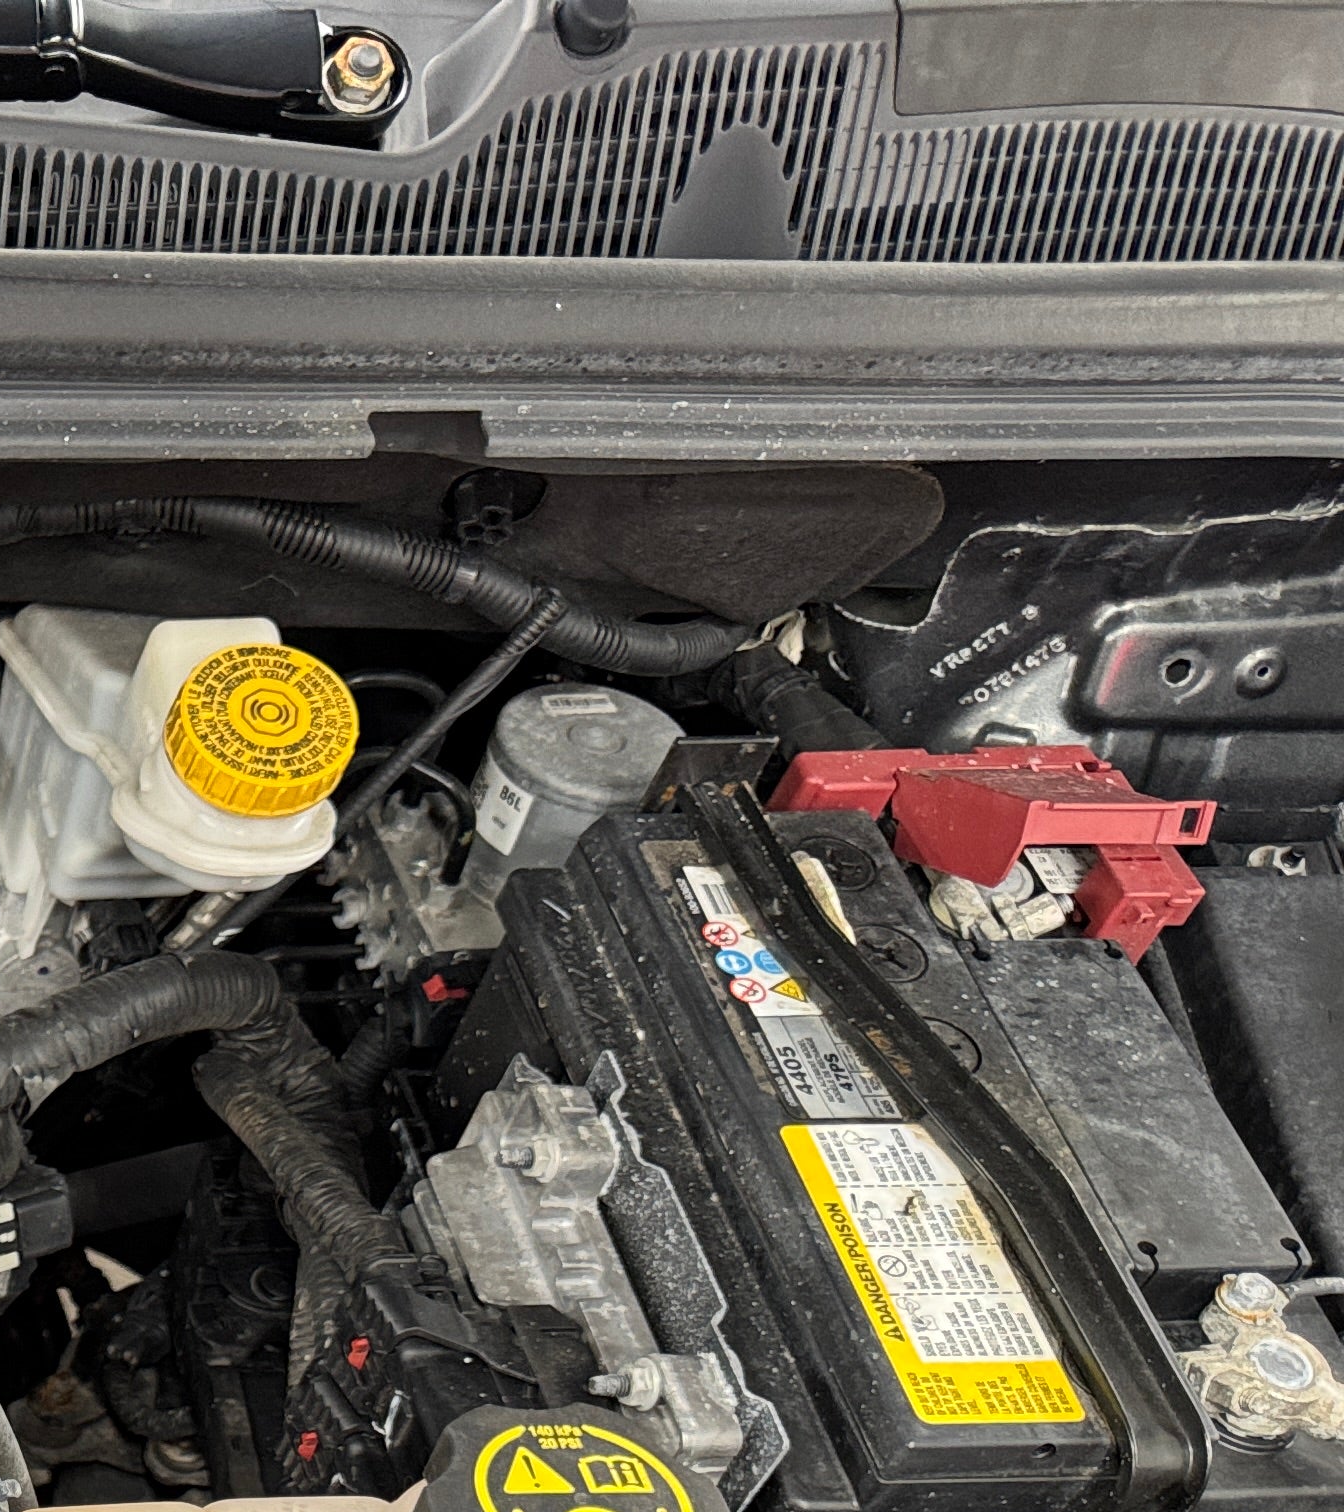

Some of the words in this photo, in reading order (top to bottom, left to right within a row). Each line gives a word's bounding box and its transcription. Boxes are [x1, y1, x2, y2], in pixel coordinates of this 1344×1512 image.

[777, 1047, 812, 1094] 4405
[824, 1053, 852, 1091] 47PS
[825, 1203, 895, 1324] DANGER/POISON
[527, 1425, 553, 1438] 140
[538, 1437, 557, 1450] 20
[559, 1437, 584, 1450] PSI
